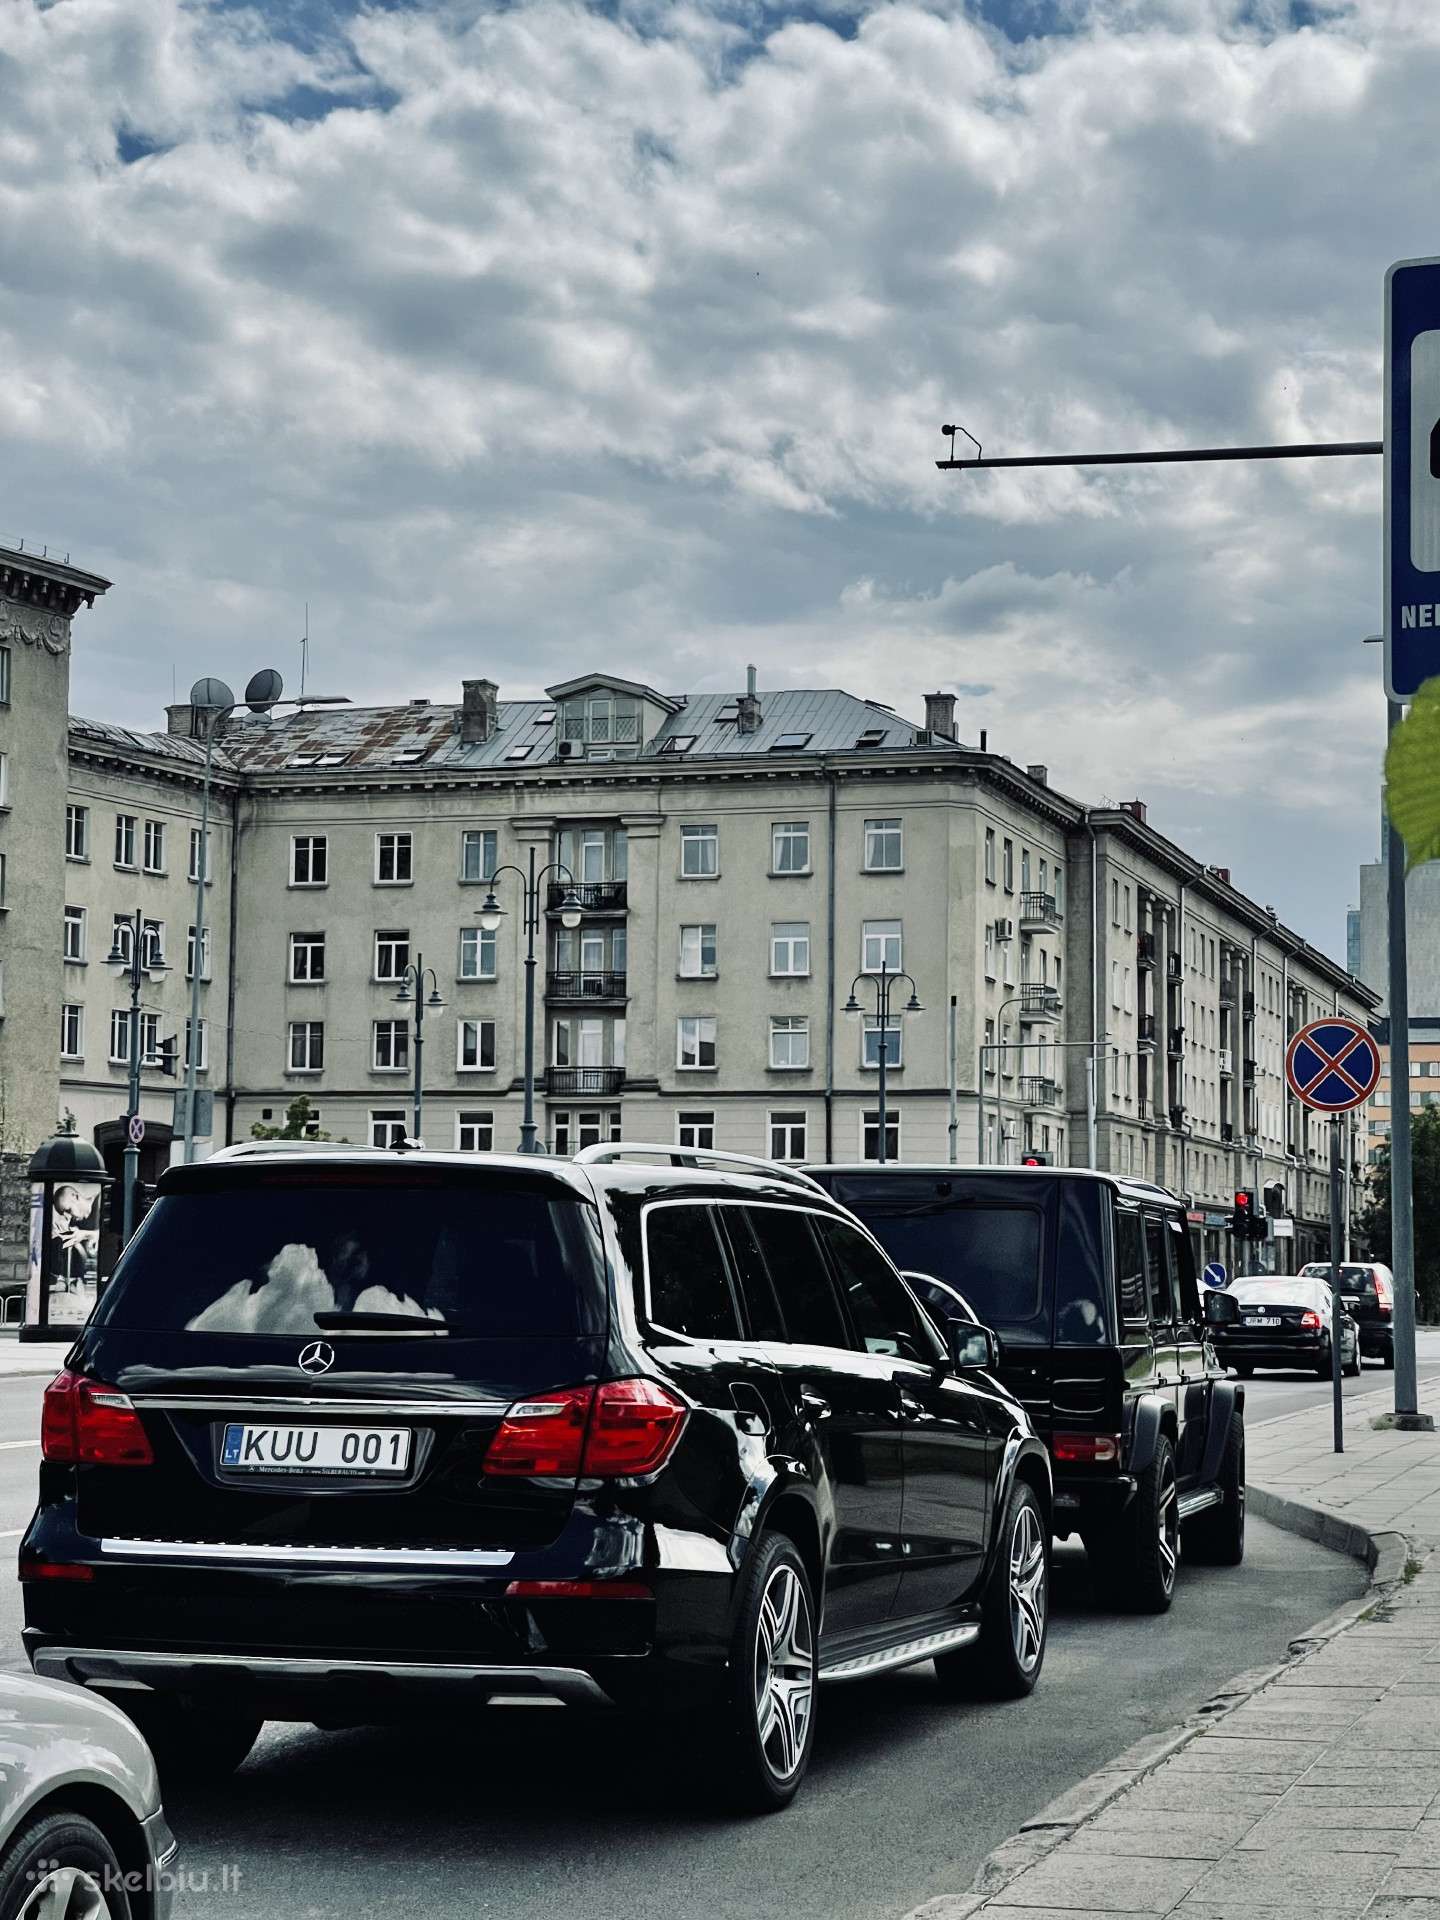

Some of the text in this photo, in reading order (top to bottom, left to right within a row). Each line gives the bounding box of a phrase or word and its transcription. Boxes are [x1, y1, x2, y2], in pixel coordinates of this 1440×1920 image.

[225, 1449, 238, 1458] LT
[244, 1430, 400, 1464] KUU 001
